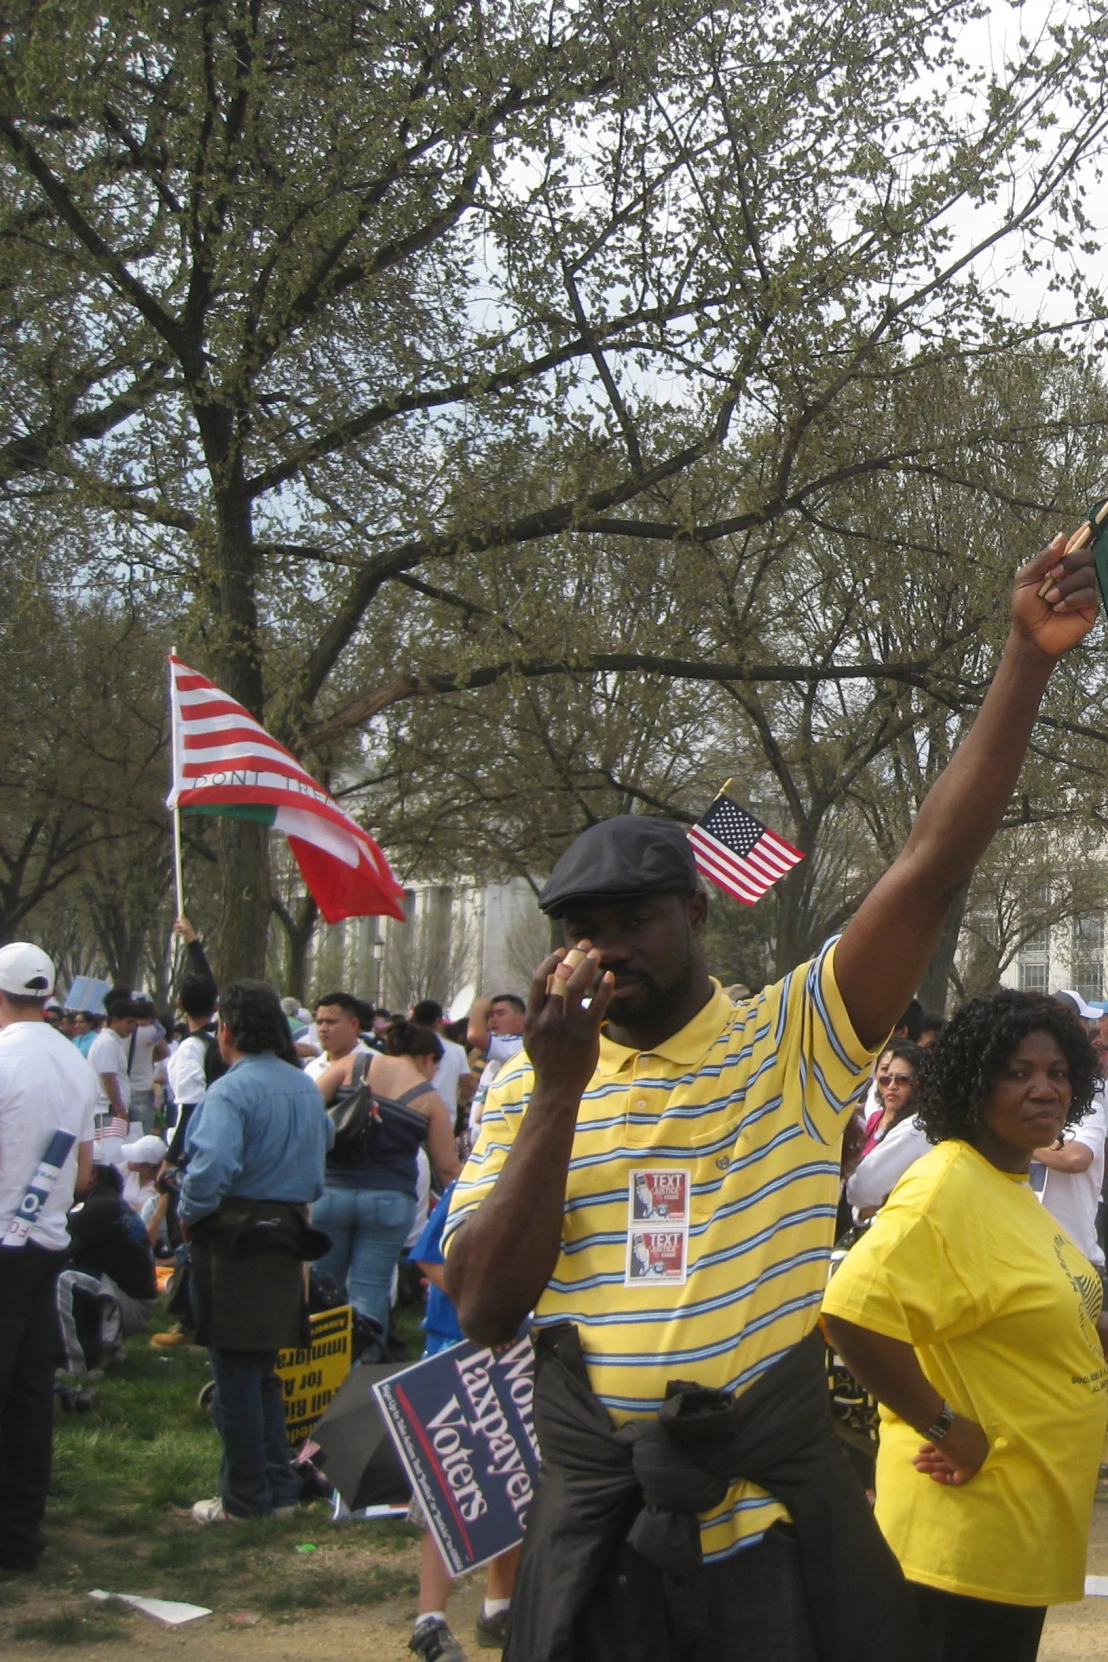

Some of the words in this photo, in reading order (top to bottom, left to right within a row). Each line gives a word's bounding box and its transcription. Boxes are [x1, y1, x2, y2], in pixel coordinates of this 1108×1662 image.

[193, 770, 264, 789] DONT
[652, 1174, 682, 1188] TEXT
[649, 1233, 680, 1247] TEXT
[276, 1336, 347, 1369] Immigra
[300, 1369, 322, 1389] for
[426, 1393, 488, 1522] Voters
